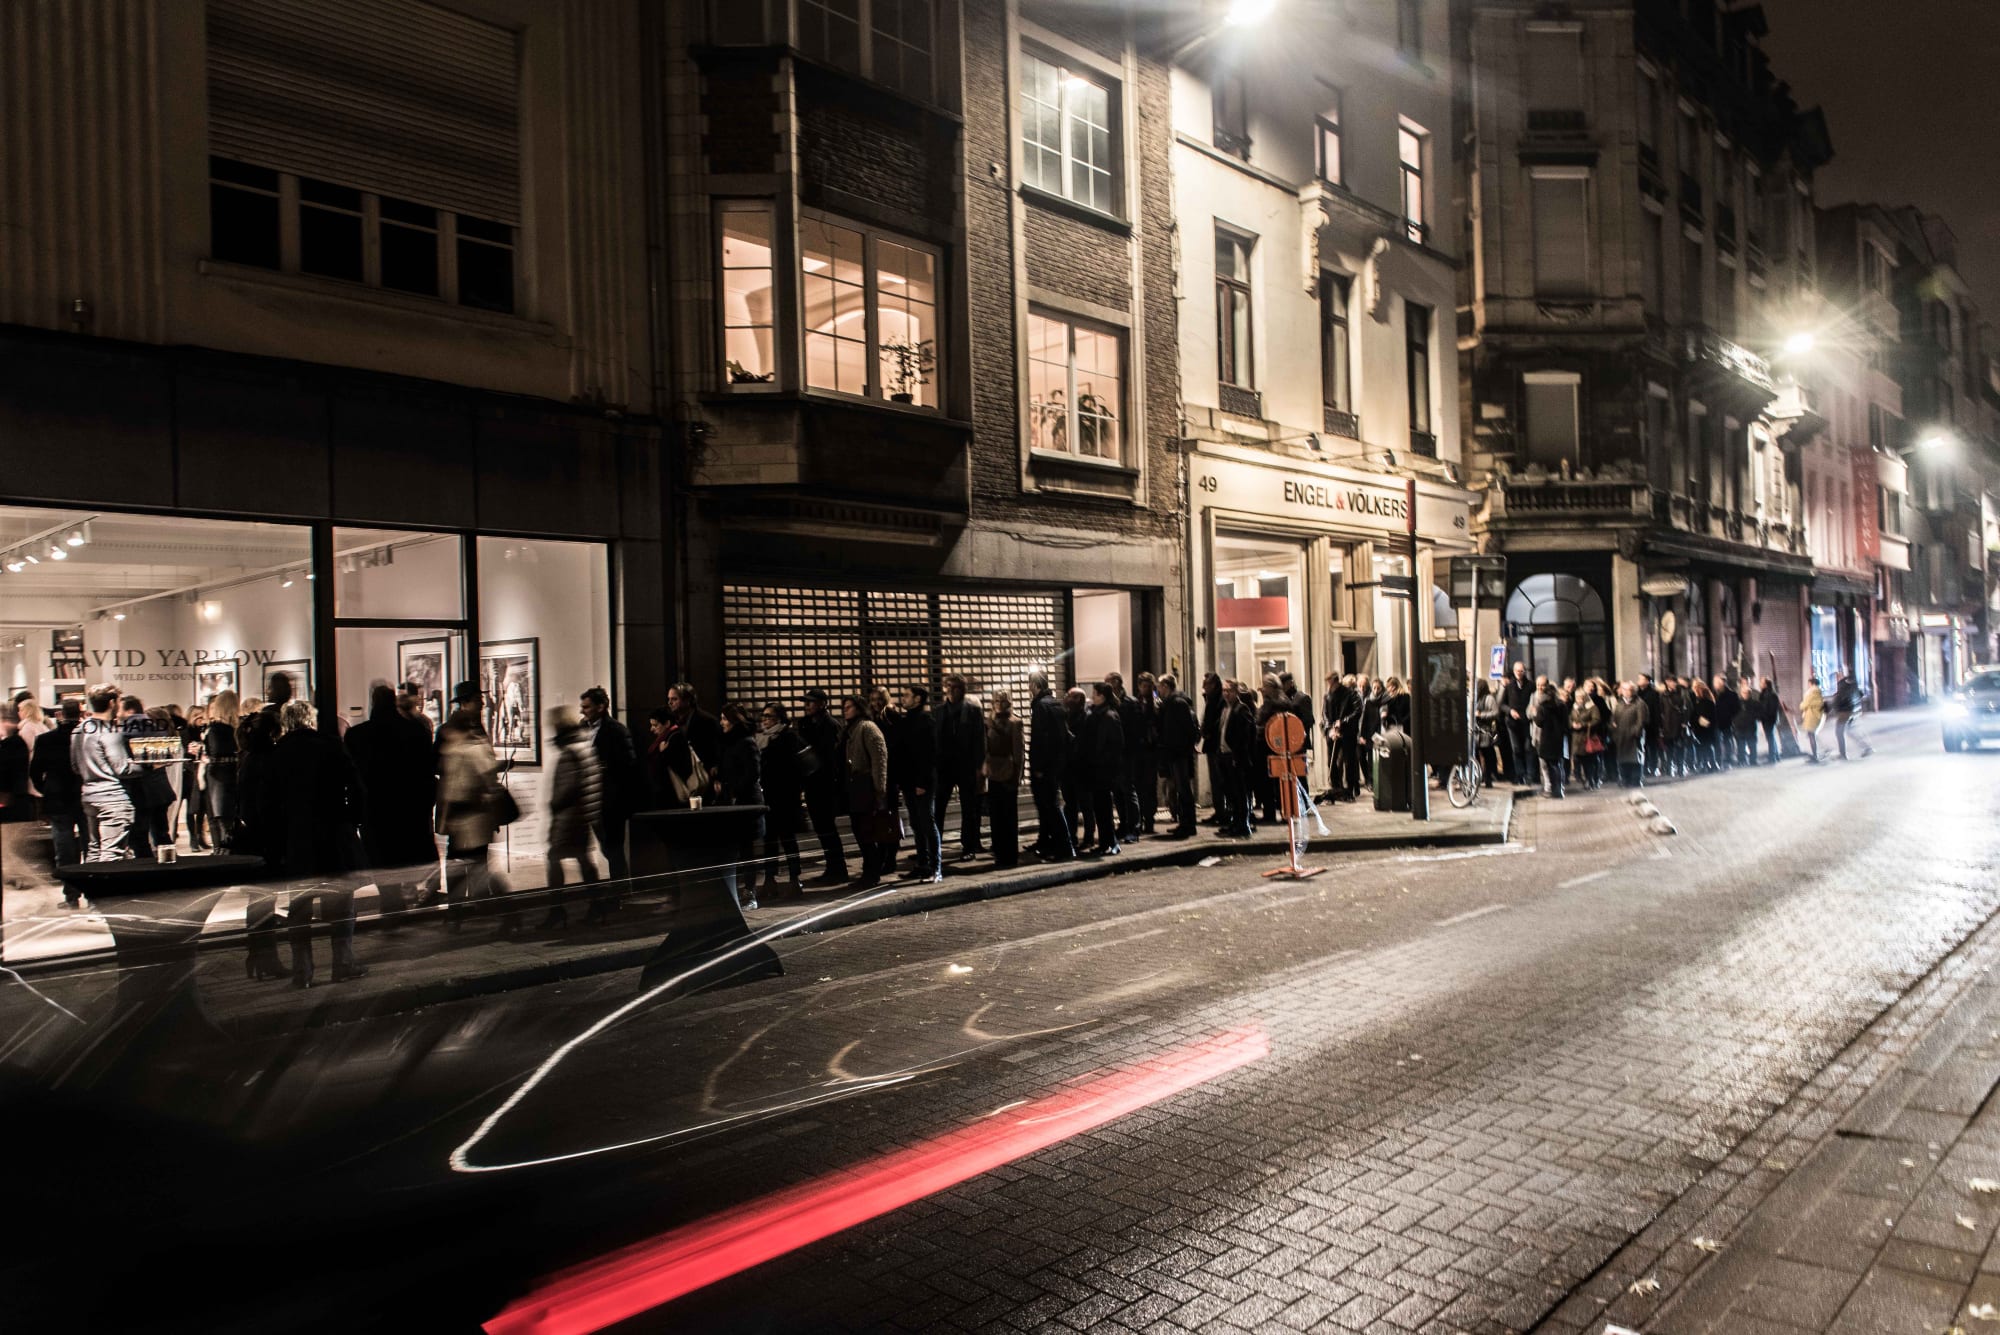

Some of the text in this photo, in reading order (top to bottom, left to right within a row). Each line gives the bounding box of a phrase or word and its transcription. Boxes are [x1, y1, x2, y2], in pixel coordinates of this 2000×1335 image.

[1199, 475, 1218, 493] 49
[1284, 480, 1408, 520] ENGEL & VÖLKERS
[1453, 514, 1466, 529] 49
[157, 649, 277, 668] YARROW
[113, 673, 145, 682] WILD
[69, 717, 168, 735] ONHARD
